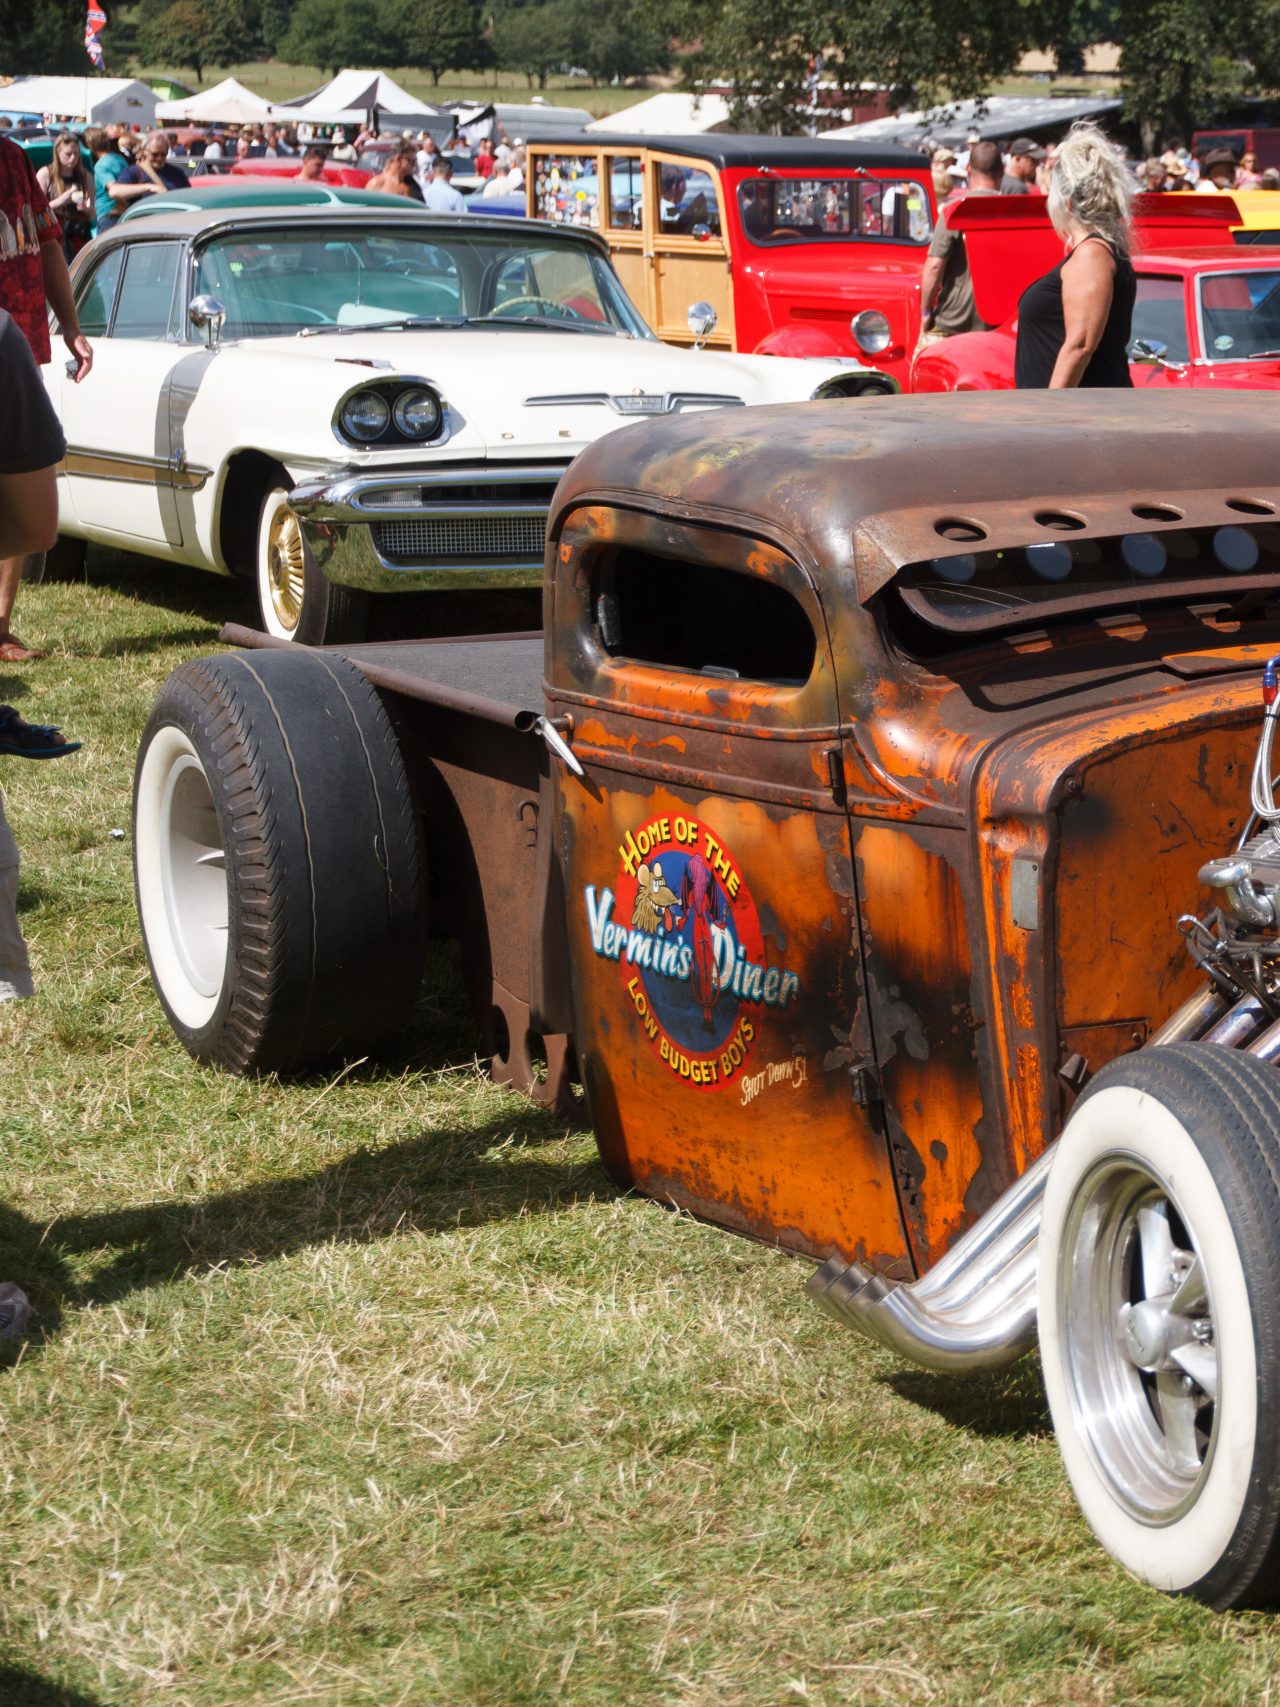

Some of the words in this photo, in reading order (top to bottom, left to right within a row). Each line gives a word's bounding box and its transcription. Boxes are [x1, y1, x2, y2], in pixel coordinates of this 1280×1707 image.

[619, 817, 671, 877] HOME
[674, 816, 699, 844] OF
[703, 832, 741, 898] THE
[585, 885, 694, 978] Vermin's
[711, 922, 800, 1005] Diner
[627, 976, 659, 1042] LOW
[660, 1040, 719, 1085] BUDGET
[721, 1015, 755, 1079] BOYS
[741, 1070, 766, 1106] SHUT
[766, 1060, 794, 1087] DOWN
